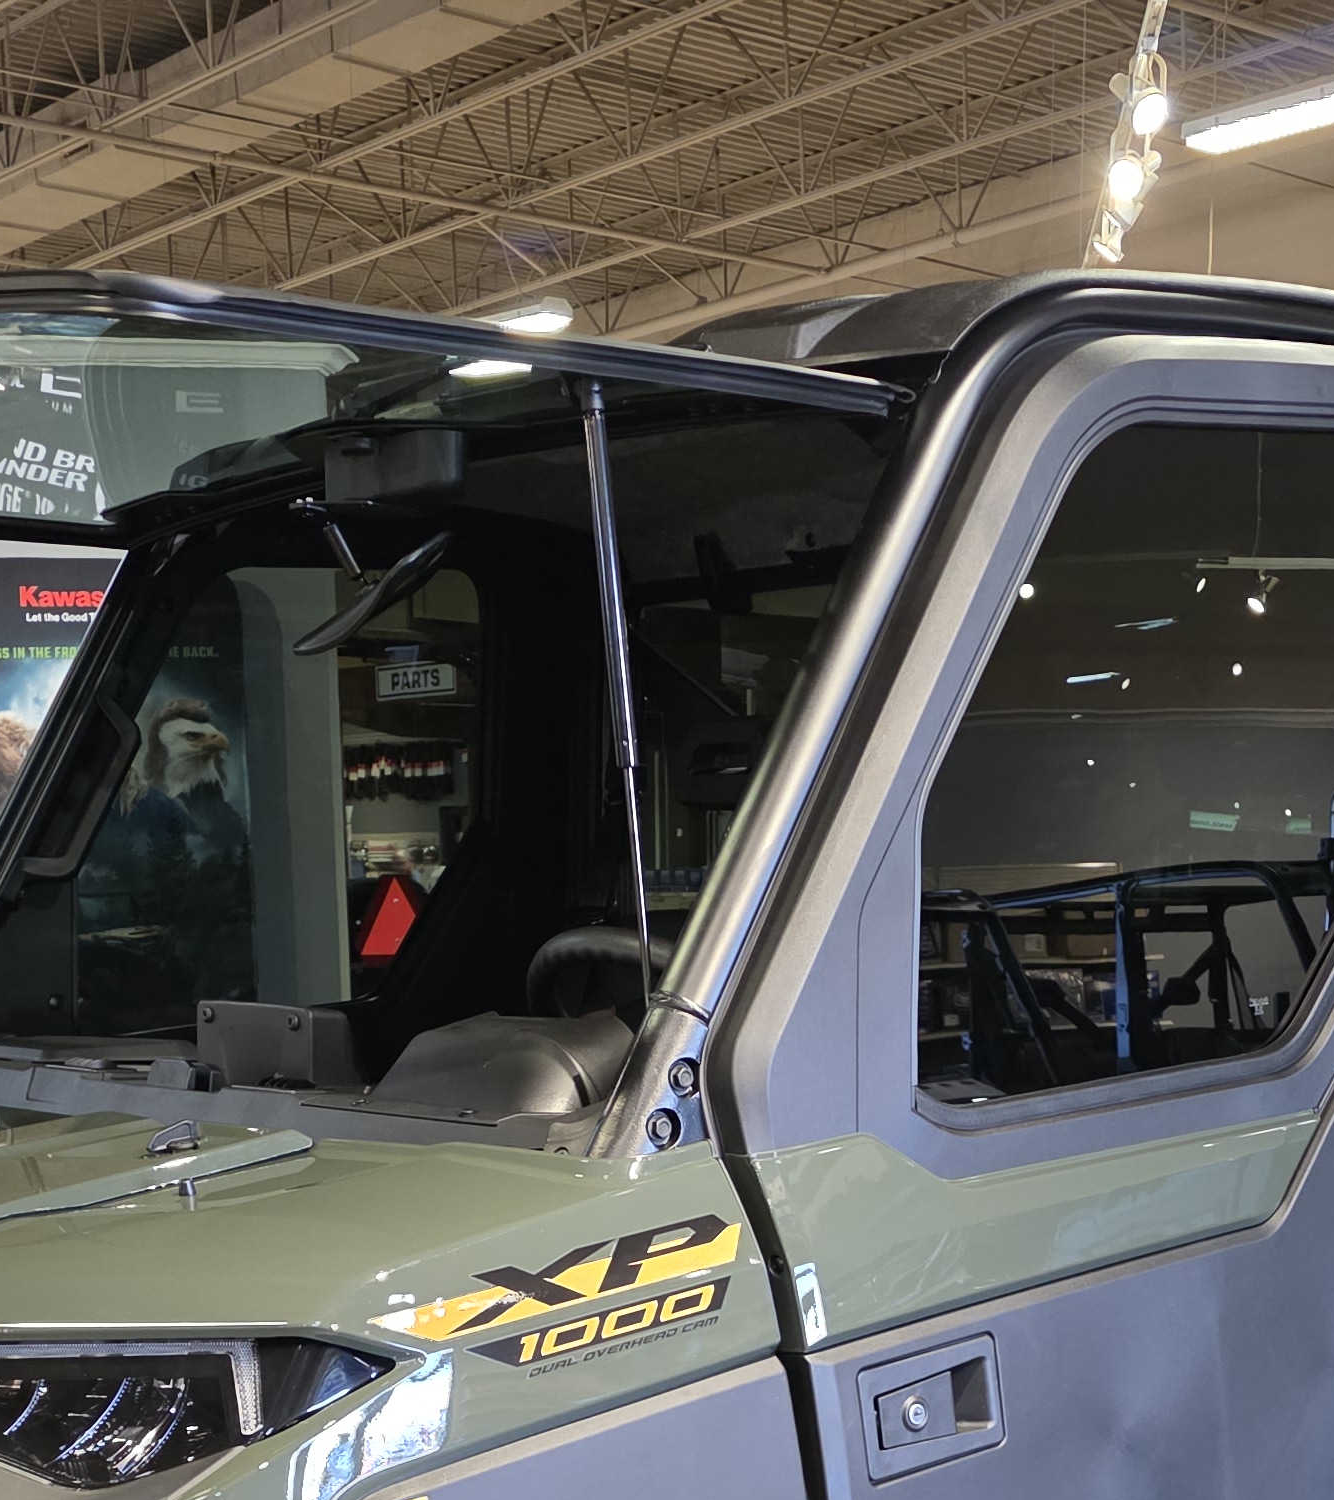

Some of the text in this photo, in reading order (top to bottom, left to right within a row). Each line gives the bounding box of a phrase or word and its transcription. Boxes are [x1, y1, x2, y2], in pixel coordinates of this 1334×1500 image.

[25, 612, 42, 622] Let
[43, 612, 60, 622] the
[61, 612, 88, 622] Good
[13, 647, 26, 659] IN
[29, 647, 52, 659] THE
[183, 646, 220, 658] BACK.
[390, 668, 441, 691] PARTS
[447, 1213, 731, 1337] XP
[519, 1284, 716, 1364] 1000
[528, 1315, 720, 1379] DUAL OVERHEAD CAM
